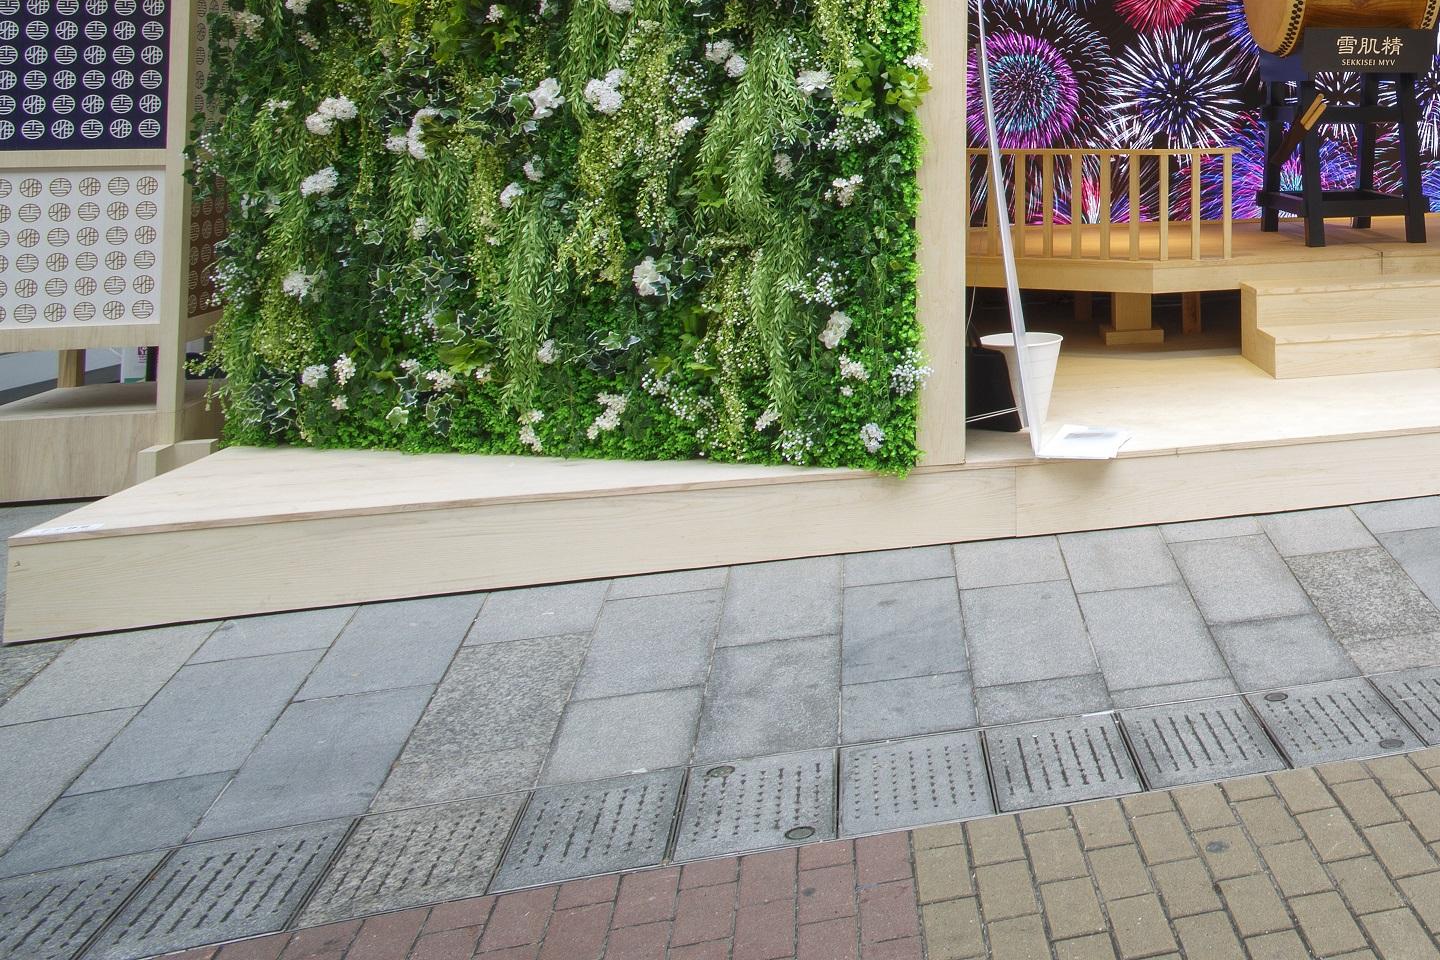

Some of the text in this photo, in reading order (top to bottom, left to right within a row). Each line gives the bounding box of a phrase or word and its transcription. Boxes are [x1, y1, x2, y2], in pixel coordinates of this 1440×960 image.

[1336, 36, 1403, 55] 雪肌精
[1341, 58, 1396, 66] SEKKISEI MYV
